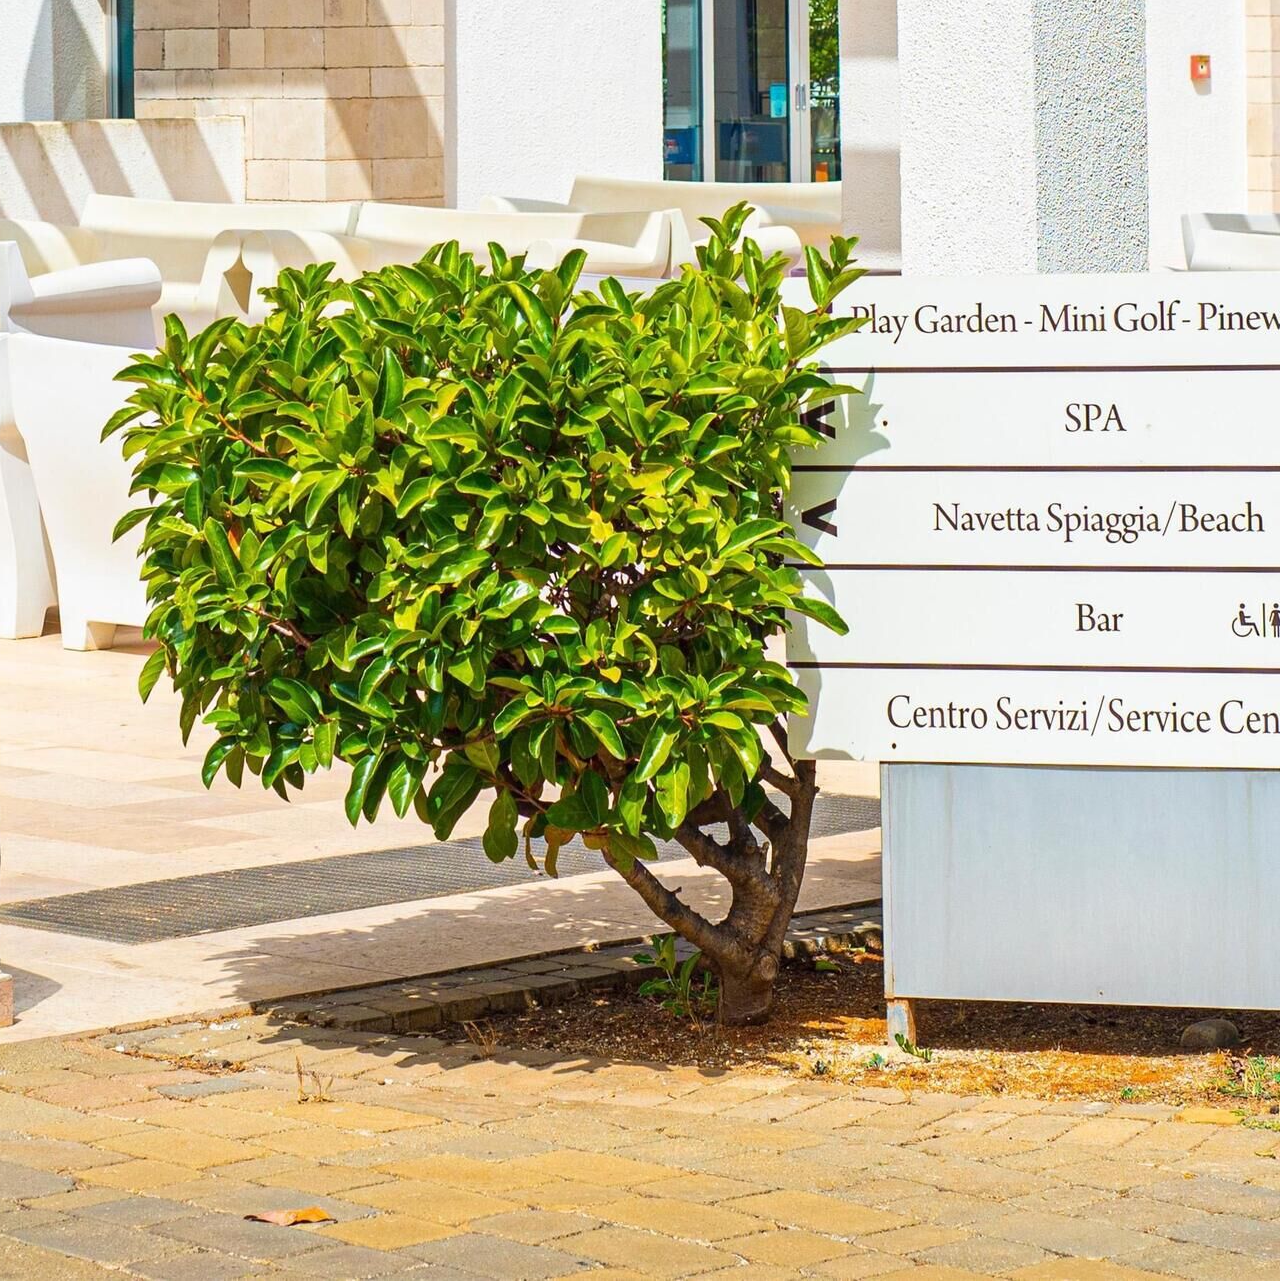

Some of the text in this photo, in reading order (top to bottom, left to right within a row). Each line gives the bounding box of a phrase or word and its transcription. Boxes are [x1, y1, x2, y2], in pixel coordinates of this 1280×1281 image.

[850, 303, 909, 345] Play
[914, 302, 1018, 334] Garden
[1039, 303, 1107, 333] Mini
[1113, 300, 1181, 333] Golf
[1065, 403, 1127, 433] SPA
[932, 500, 1265, 544] Navetta Spiaggia/Beach
[1075, 603, 1124, 633] Bar
[887, 694, 988, 730] Centro
[995, 695, 1211, 736] Servizi/Service
